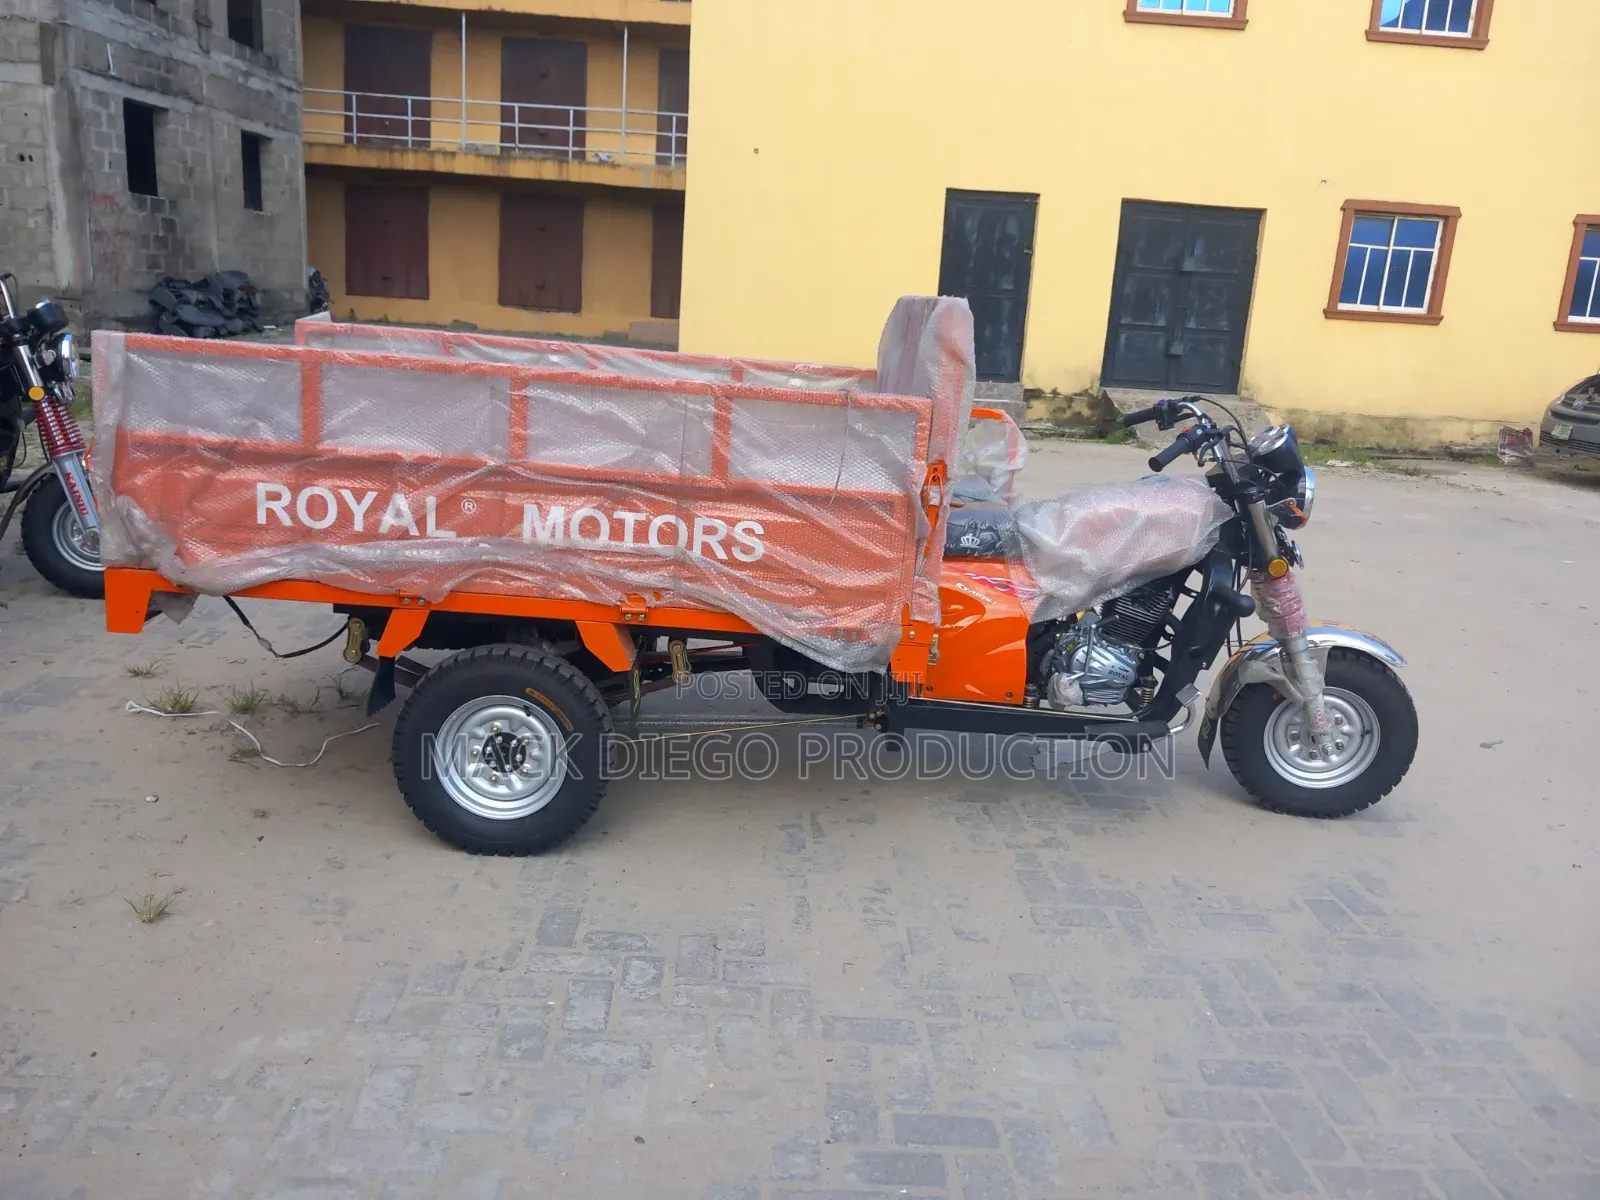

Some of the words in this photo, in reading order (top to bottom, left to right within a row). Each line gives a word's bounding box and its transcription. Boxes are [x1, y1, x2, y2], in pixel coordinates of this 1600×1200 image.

[256, 482, 457, 538] ROYAL
[522, 503, 765, 563] MOTORS
[1108, 669, 1129, 680] ROYAL
